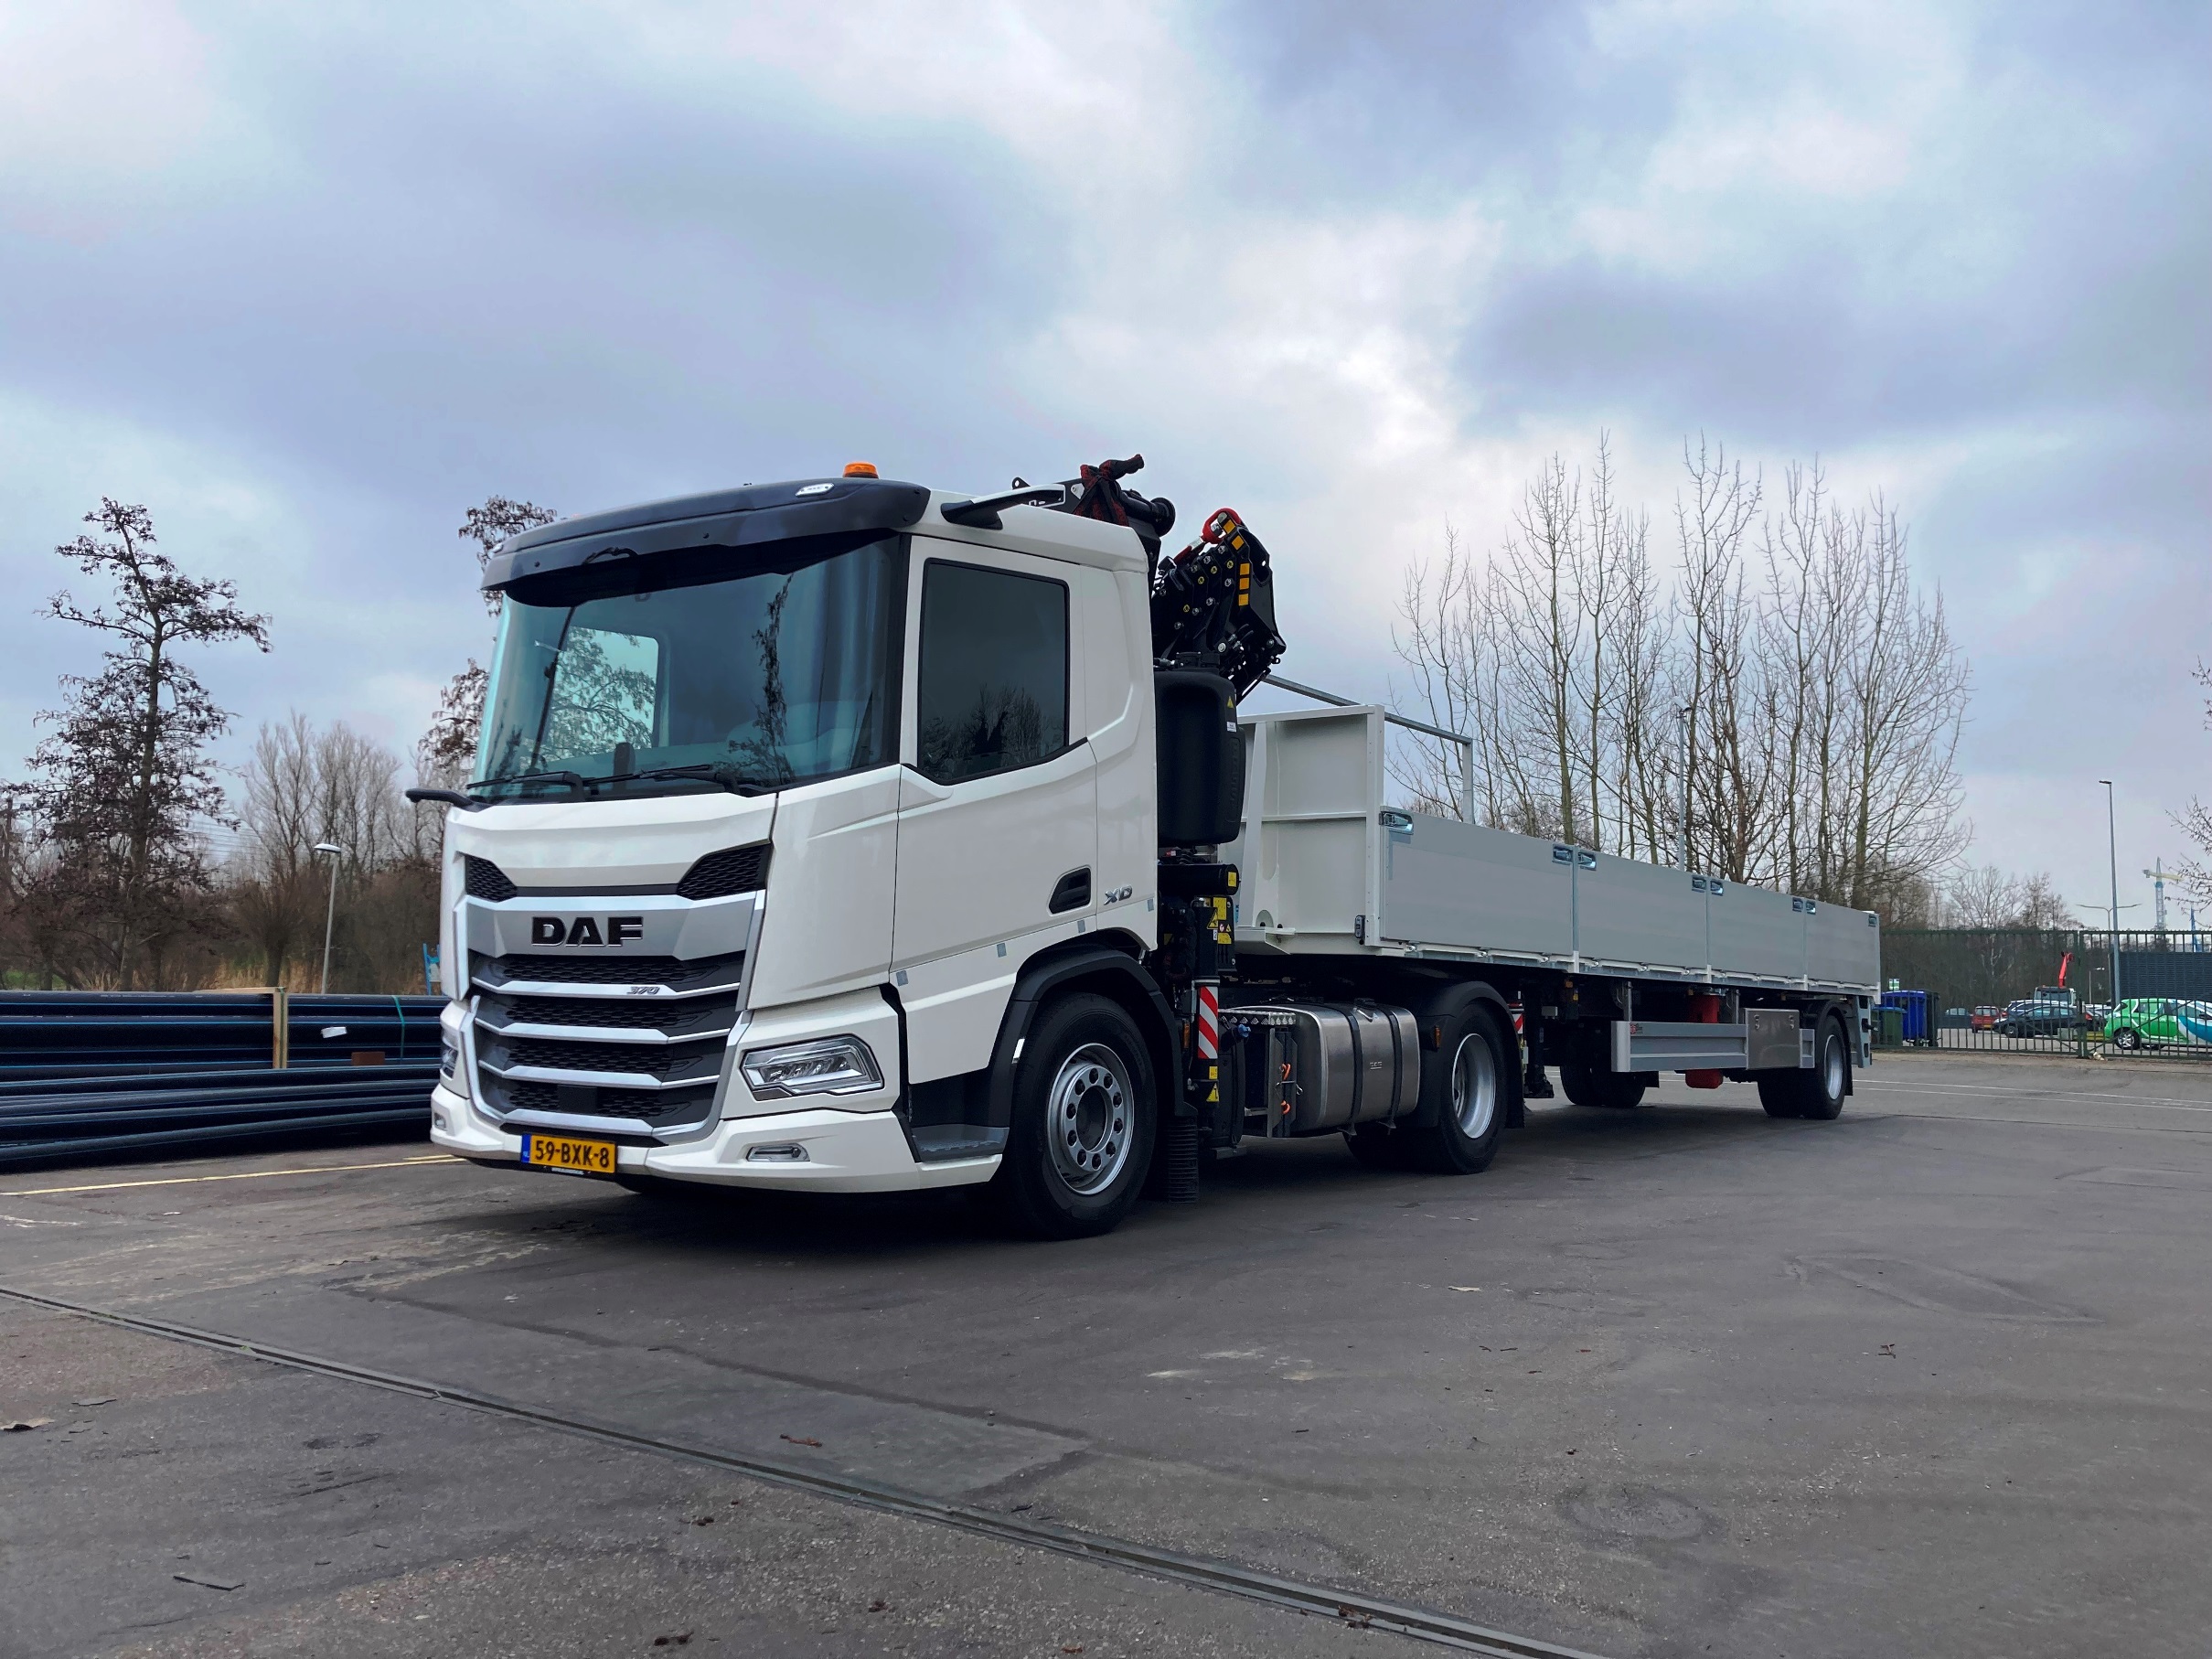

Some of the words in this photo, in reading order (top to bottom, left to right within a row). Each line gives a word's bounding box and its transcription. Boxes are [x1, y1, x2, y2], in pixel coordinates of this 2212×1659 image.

[1104, 884, 1133, 905] XD
[531, 916, 644, 947] DAF
[626, 986, 660, 995] 370
[535, 1140, 610, 1168] 59-BXK-8
